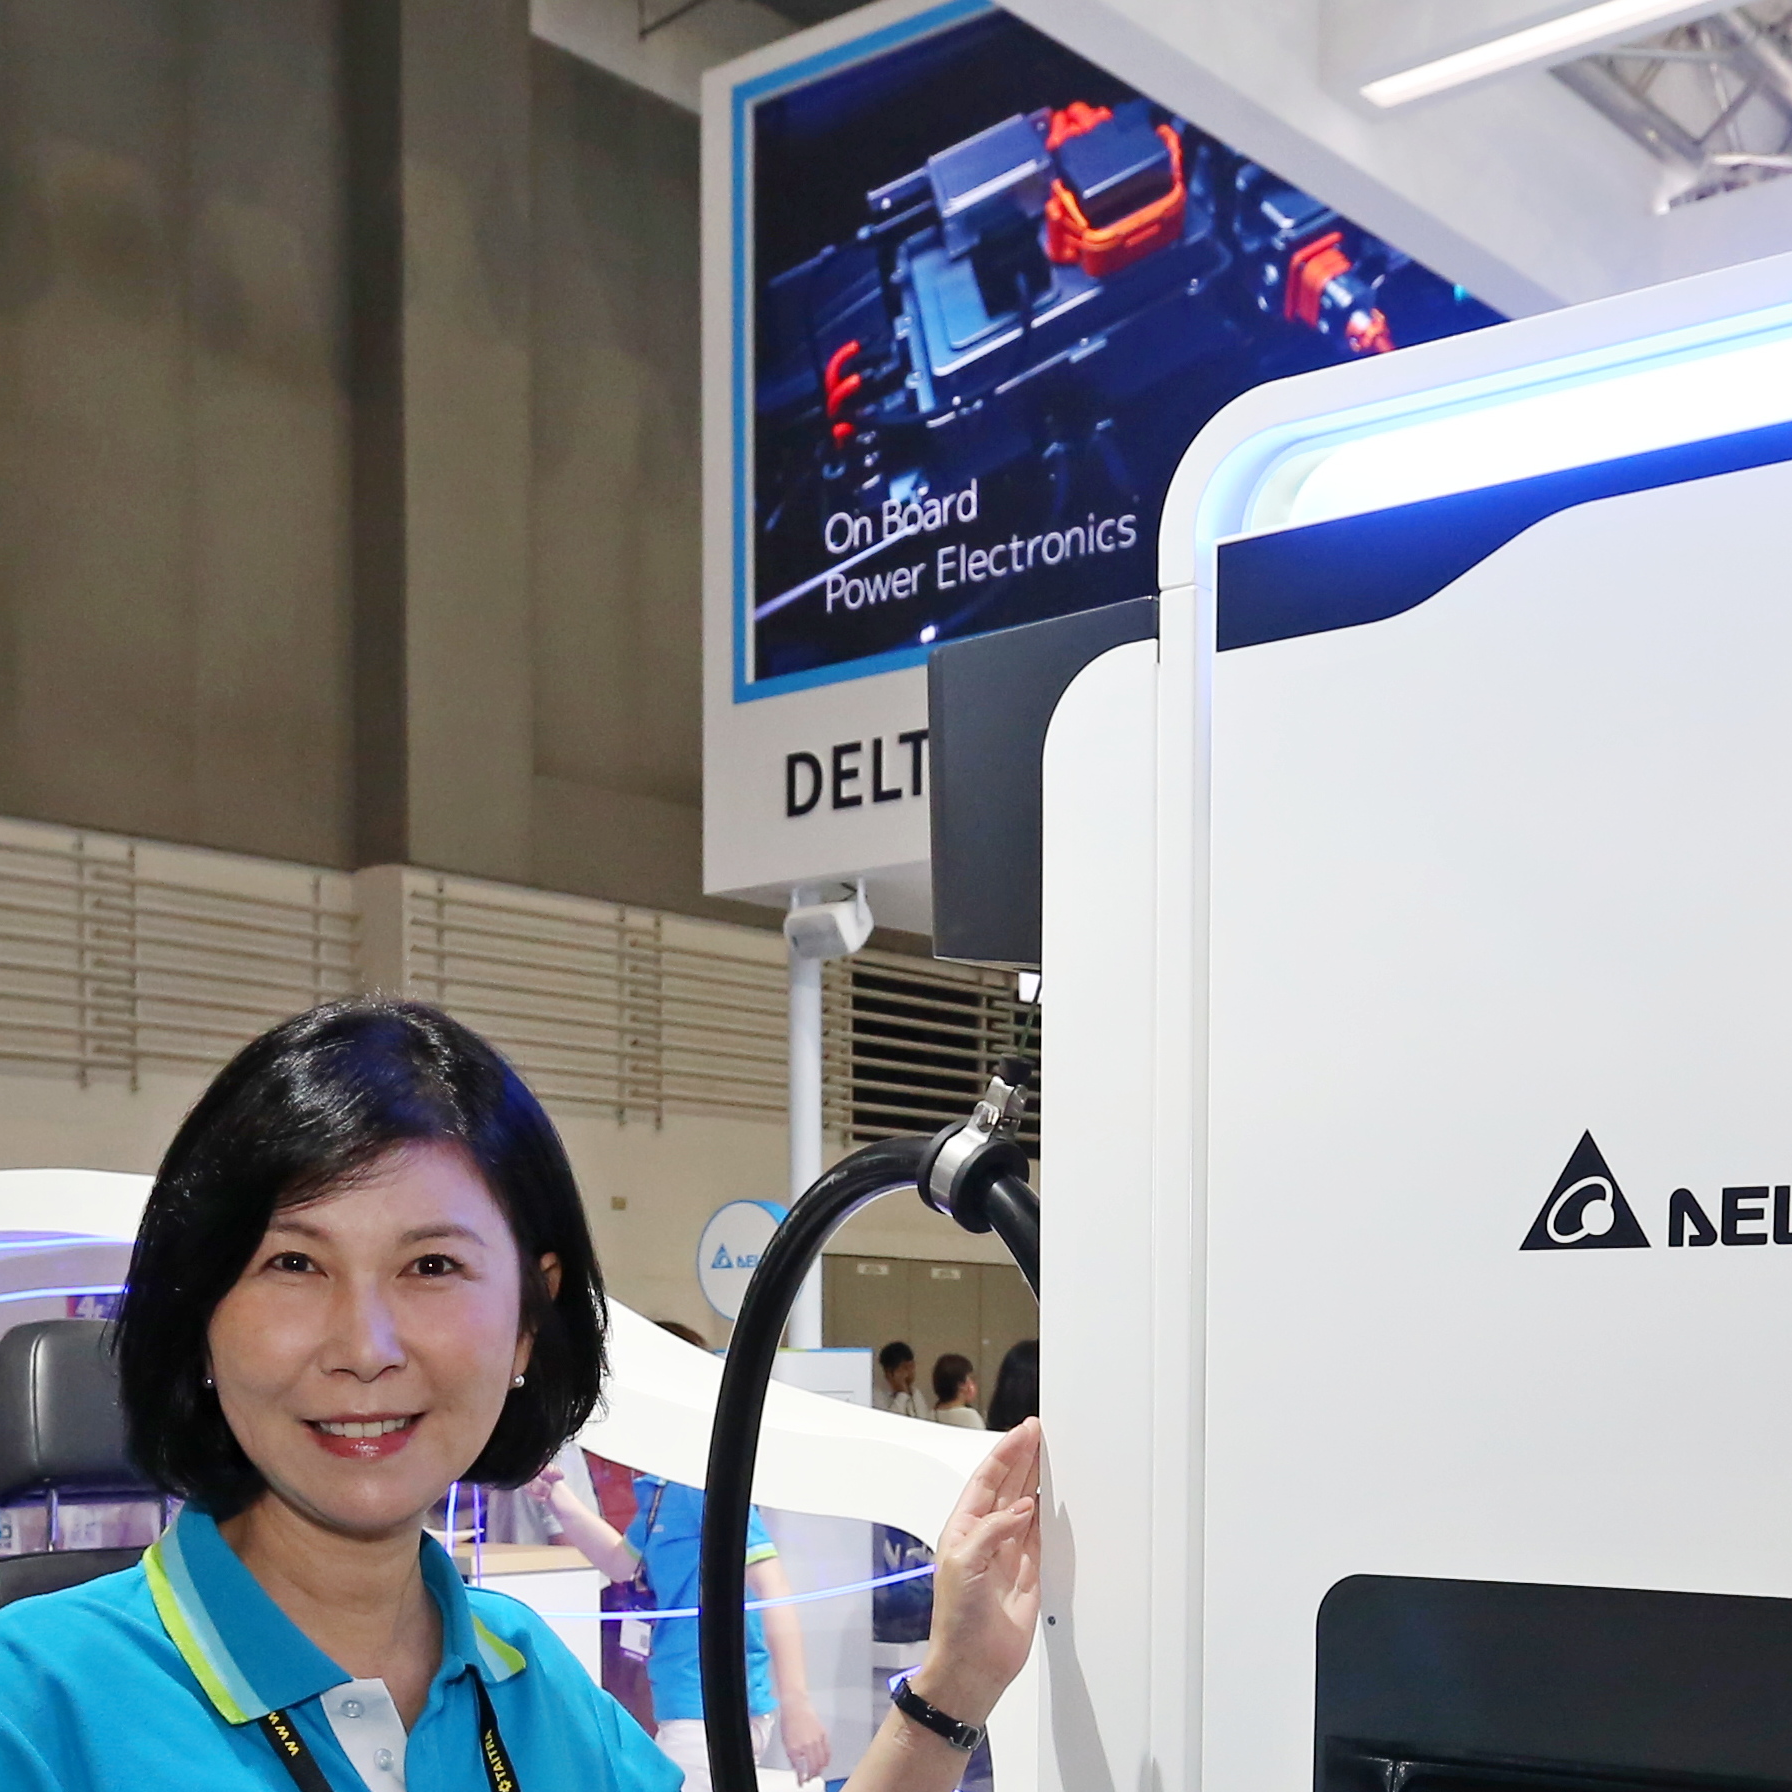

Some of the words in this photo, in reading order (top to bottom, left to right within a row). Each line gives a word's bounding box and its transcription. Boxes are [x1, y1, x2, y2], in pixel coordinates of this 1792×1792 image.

[825, 512, 873, 554] On
[882, 478, 978, 540] Board
[826, 562, 927, 614] Power
[937, 512, 1137, 590] Electronics
[786, 729, 929, 817] DELT
